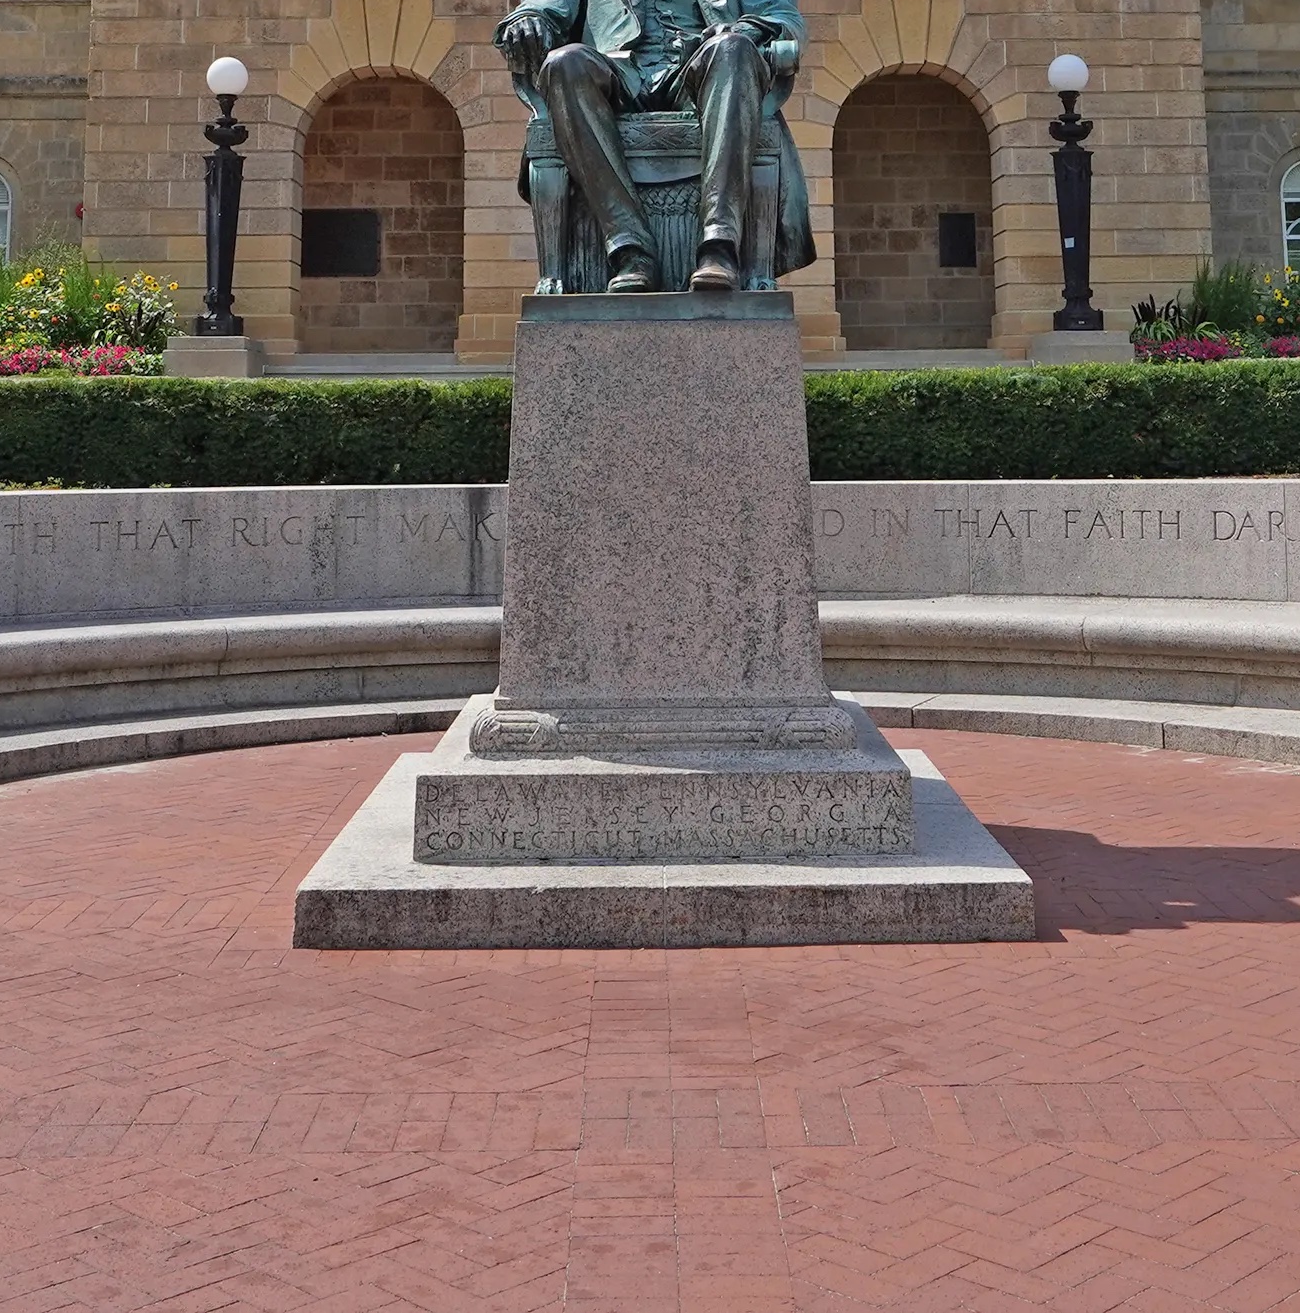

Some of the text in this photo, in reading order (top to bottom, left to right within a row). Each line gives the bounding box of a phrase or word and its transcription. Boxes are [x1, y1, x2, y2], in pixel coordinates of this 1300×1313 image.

[89, 518, 202, 552] THAT
[230, 514, 366, 548] RIGHT
[871, 507, 912, 538] IN
[933, 508, 1038, 539] THAT
[1063, 509, 1182, 540] FAITH
[424, 778, 901, 804] DELAWARE PENNSYLVANIA
[425, 803, 902, 827] NEW JERSEY GEORGIA
[425, 826, 902, 852] CONNECTICUT MASSACHUSETTS
